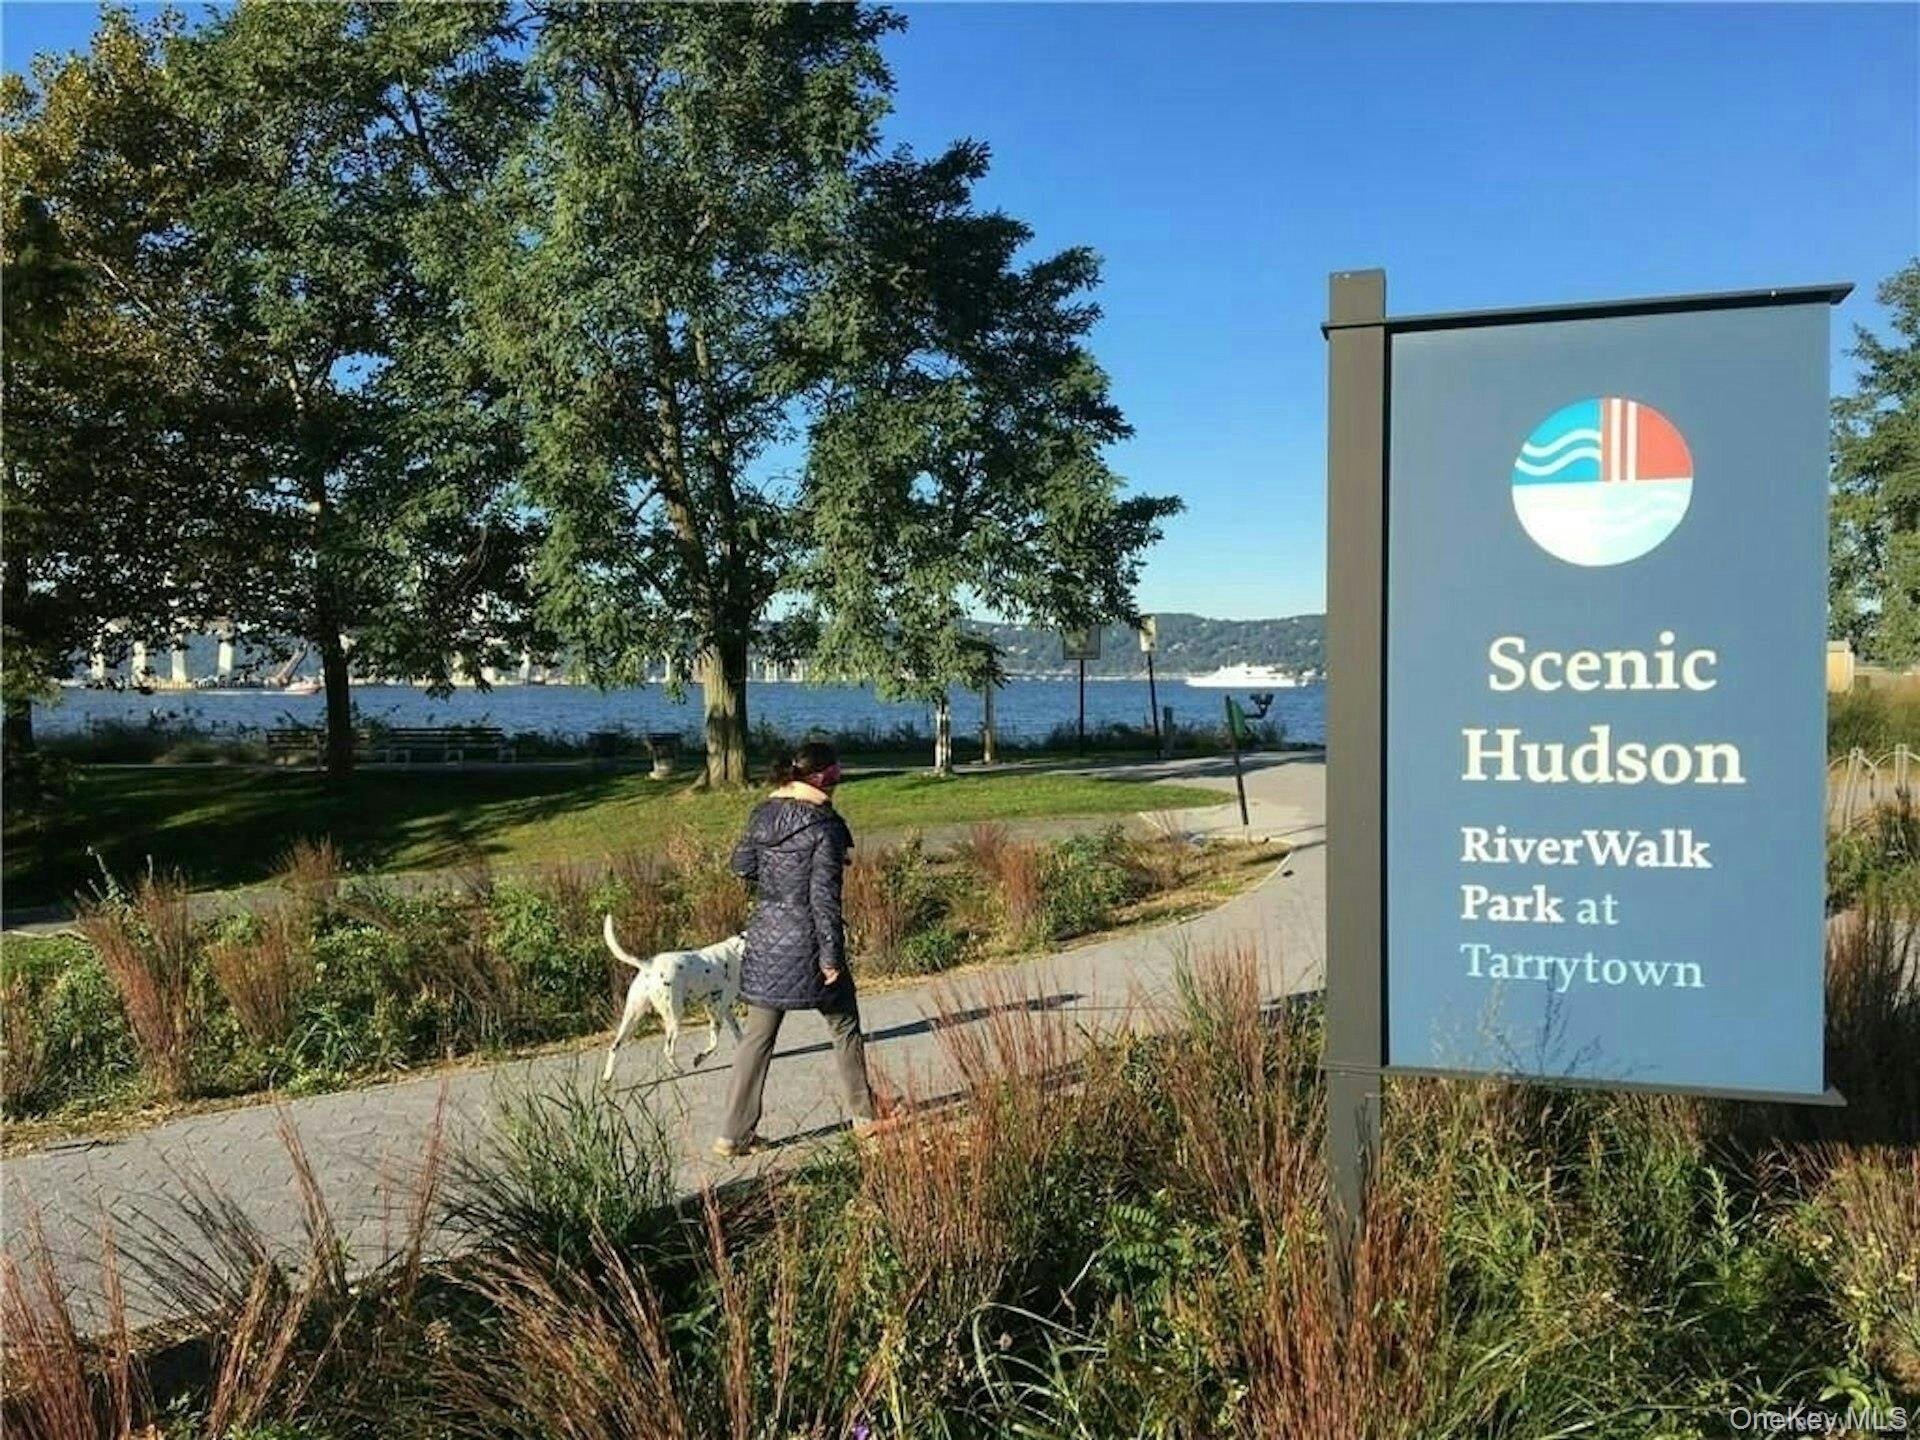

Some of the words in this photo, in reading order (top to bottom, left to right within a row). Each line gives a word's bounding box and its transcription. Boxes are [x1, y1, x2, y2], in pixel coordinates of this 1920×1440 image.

[1488, 631, 1718, 692] Scenic
[1461, 724, 1747, 785] Hudson
[1460, 826, 1713, 869] RiverWalk
[1460, 884, 1565, 923] Park
[1576, 894, 1620, 926] at
[1460, 944, 1706, 993] Tarrytown
